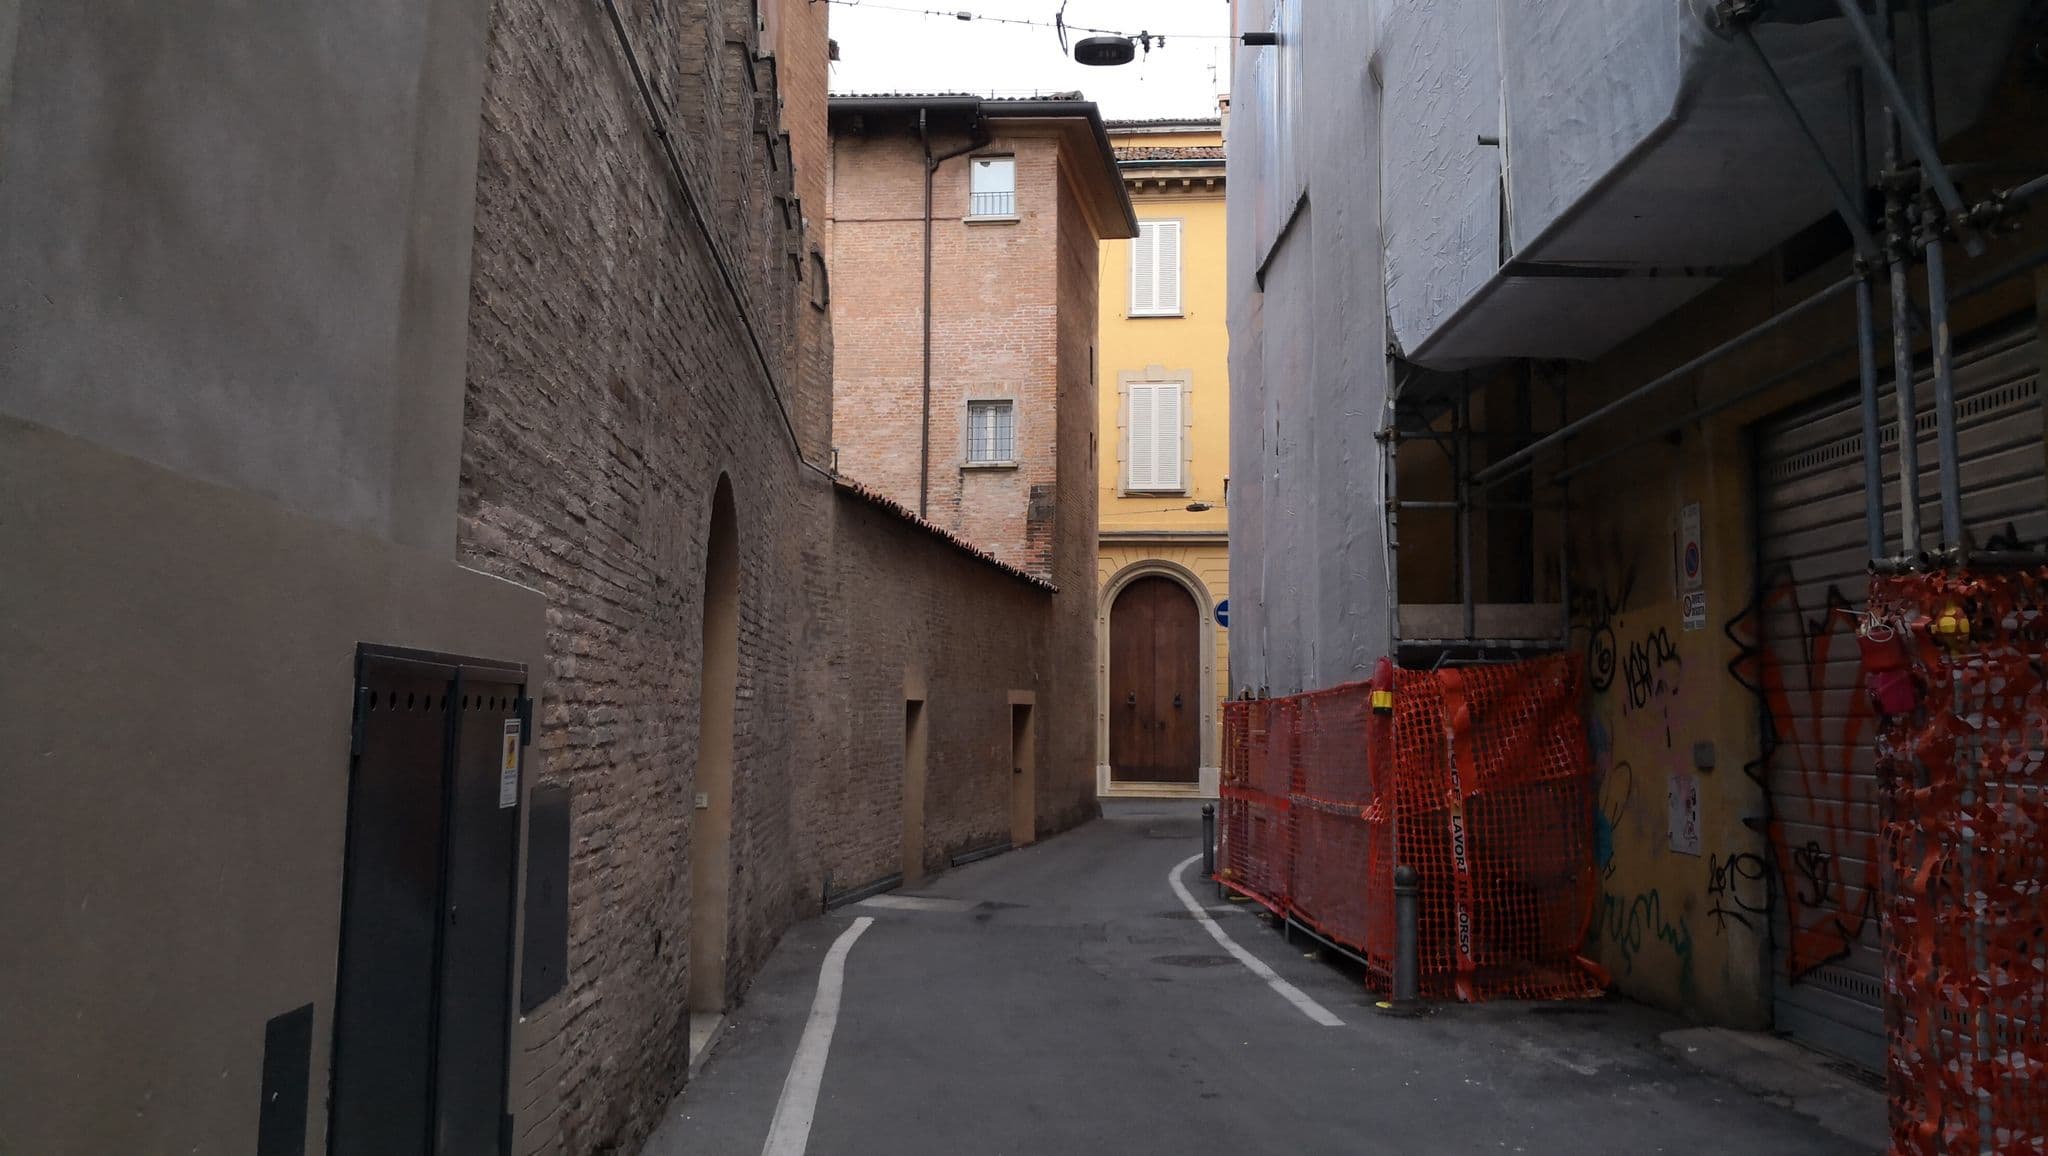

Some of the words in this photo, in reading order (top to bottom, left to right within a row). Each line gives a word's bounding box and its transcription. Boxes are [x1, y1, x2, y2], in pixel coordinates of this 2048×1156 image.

[1453, 815, 1467, 874] LAVORI
[1459, 880, 1468, 898] IN
[1459, 902, 1470, 955] CORSO
